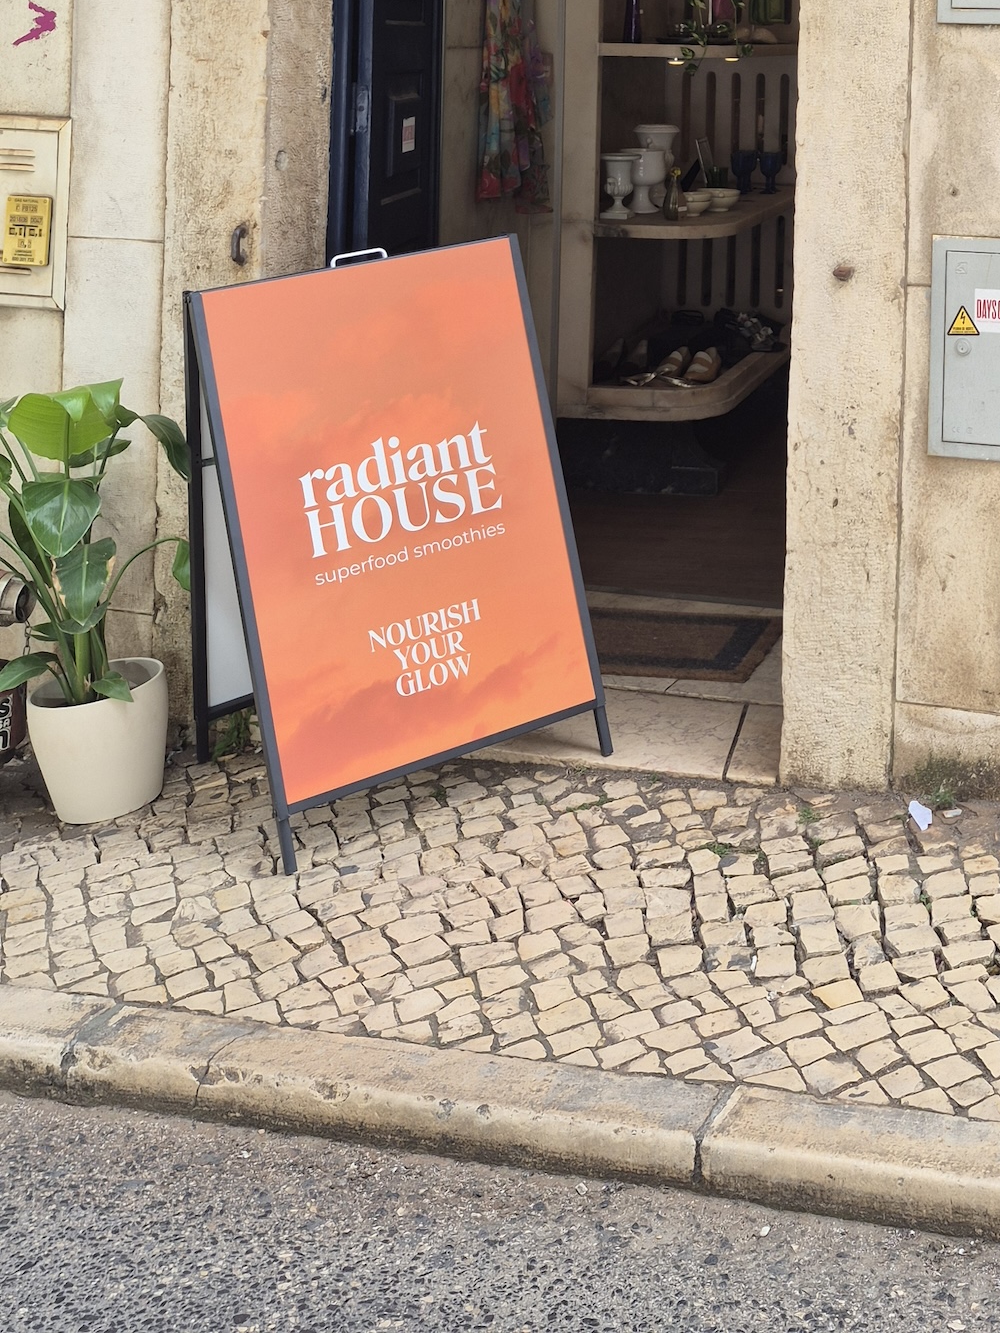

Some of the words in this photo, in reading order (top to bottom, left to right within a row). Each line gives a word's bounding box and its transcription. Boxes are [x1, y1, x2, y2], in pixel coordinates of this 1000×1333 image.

[976, 299, 997, 320] DAYS
[299, 420, 493, 509] radiant
[304, 463, 503, 559] HOUSE
[315, 546, 409, 586] superfood
[413, 523, 506, 558] smoothies
[368, 598, 481, 653] NOURISH
[393, 630, 467, 671] YOUR
[396, 653, 472, 697] GLOW
